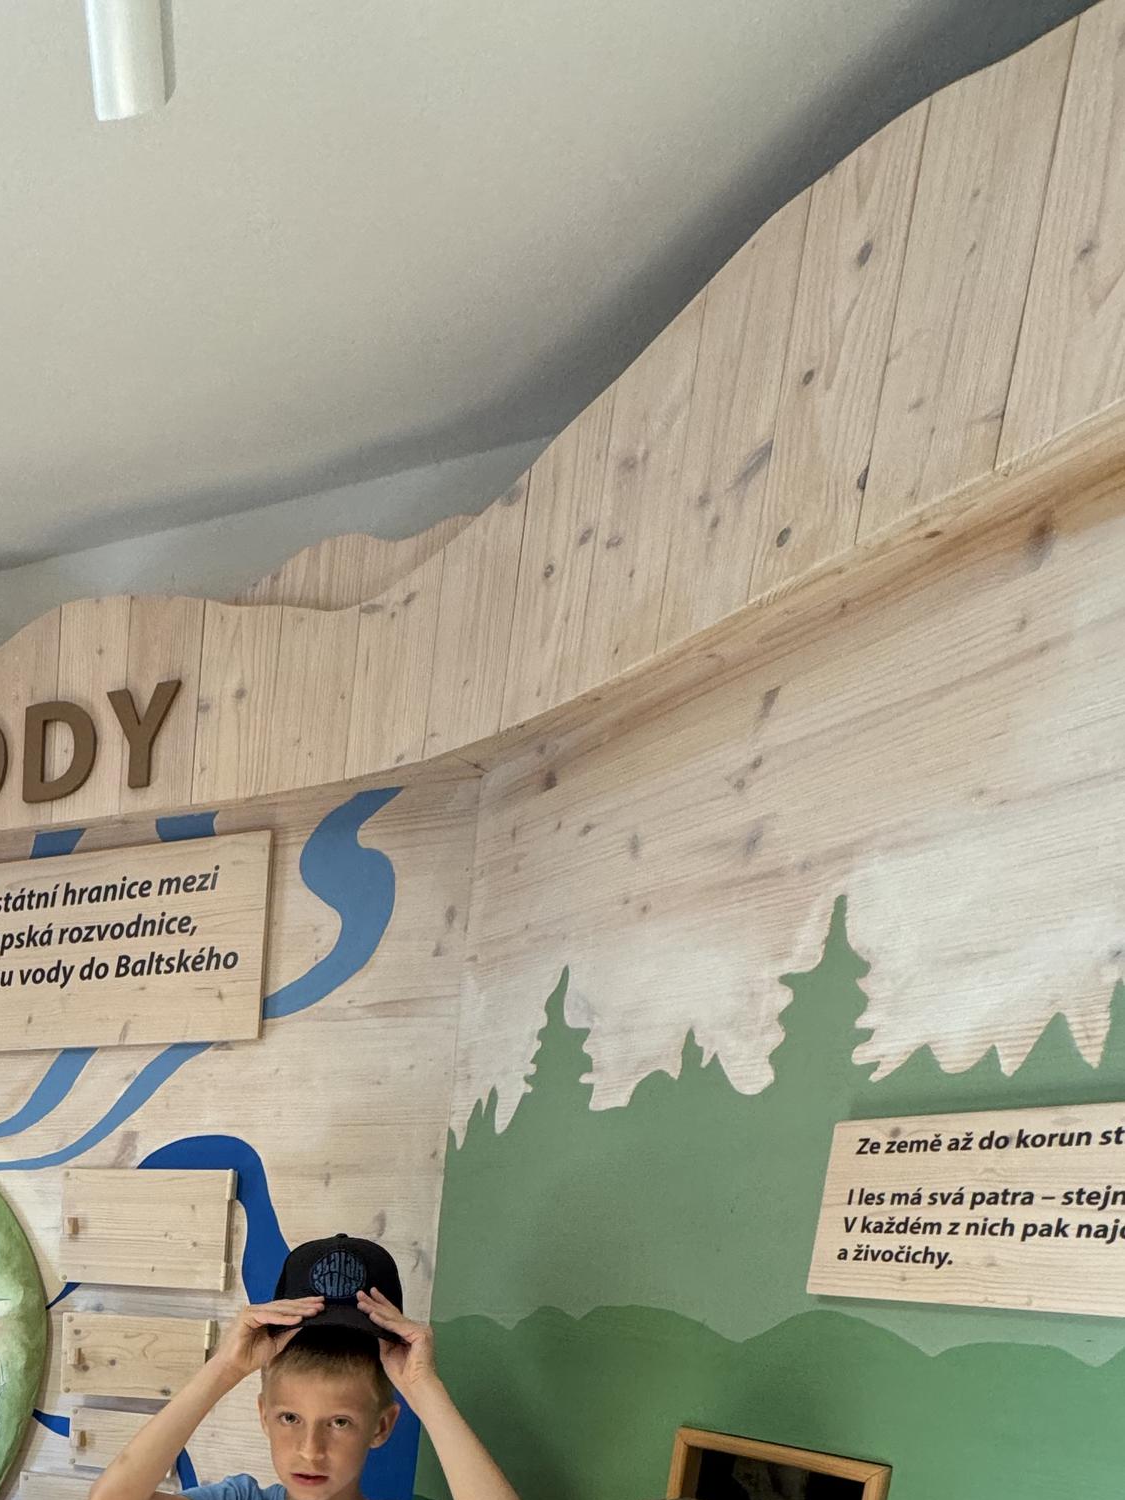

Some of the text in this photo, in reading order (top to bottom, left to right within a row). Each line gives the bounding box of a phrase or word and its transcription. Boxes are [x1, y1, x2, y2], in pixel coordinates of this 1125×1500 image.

[62, 875, 152, 907] hranice
[157, 865, 220, 897] mezi
[58, 911, 197, 945] rozvodnice,
[19, 959, 75, 989] vody
[79, 956, 109, 981] do
[114, 946, 239, 978] Baltského
[856, 1138, 881, 1155] Ze
[885, 1133, 942, 1155] země
[947, 1131, 973, 1151] až
[978, 1131, 1009, 1150] do
[1015, 1129, 1092, 1149] korun
[847, 1189, 855, 1206] I
[858, 1188, 885, 1206] les
[890, 1187, 922, 1206] má
[927, 1186, 964, 1206] svá
[969, 1188, 1034, 1210] patra
[844, 1216, 857, 1233] V
[861, 1216, 942, 1236] každém
[948, 1224, 959, 1236] z
[965, 1217, 1015, 1237] nich
[1021, 1218, 1070, 1242] pak
[837, 1245, 954, 1269] a živočichy.
